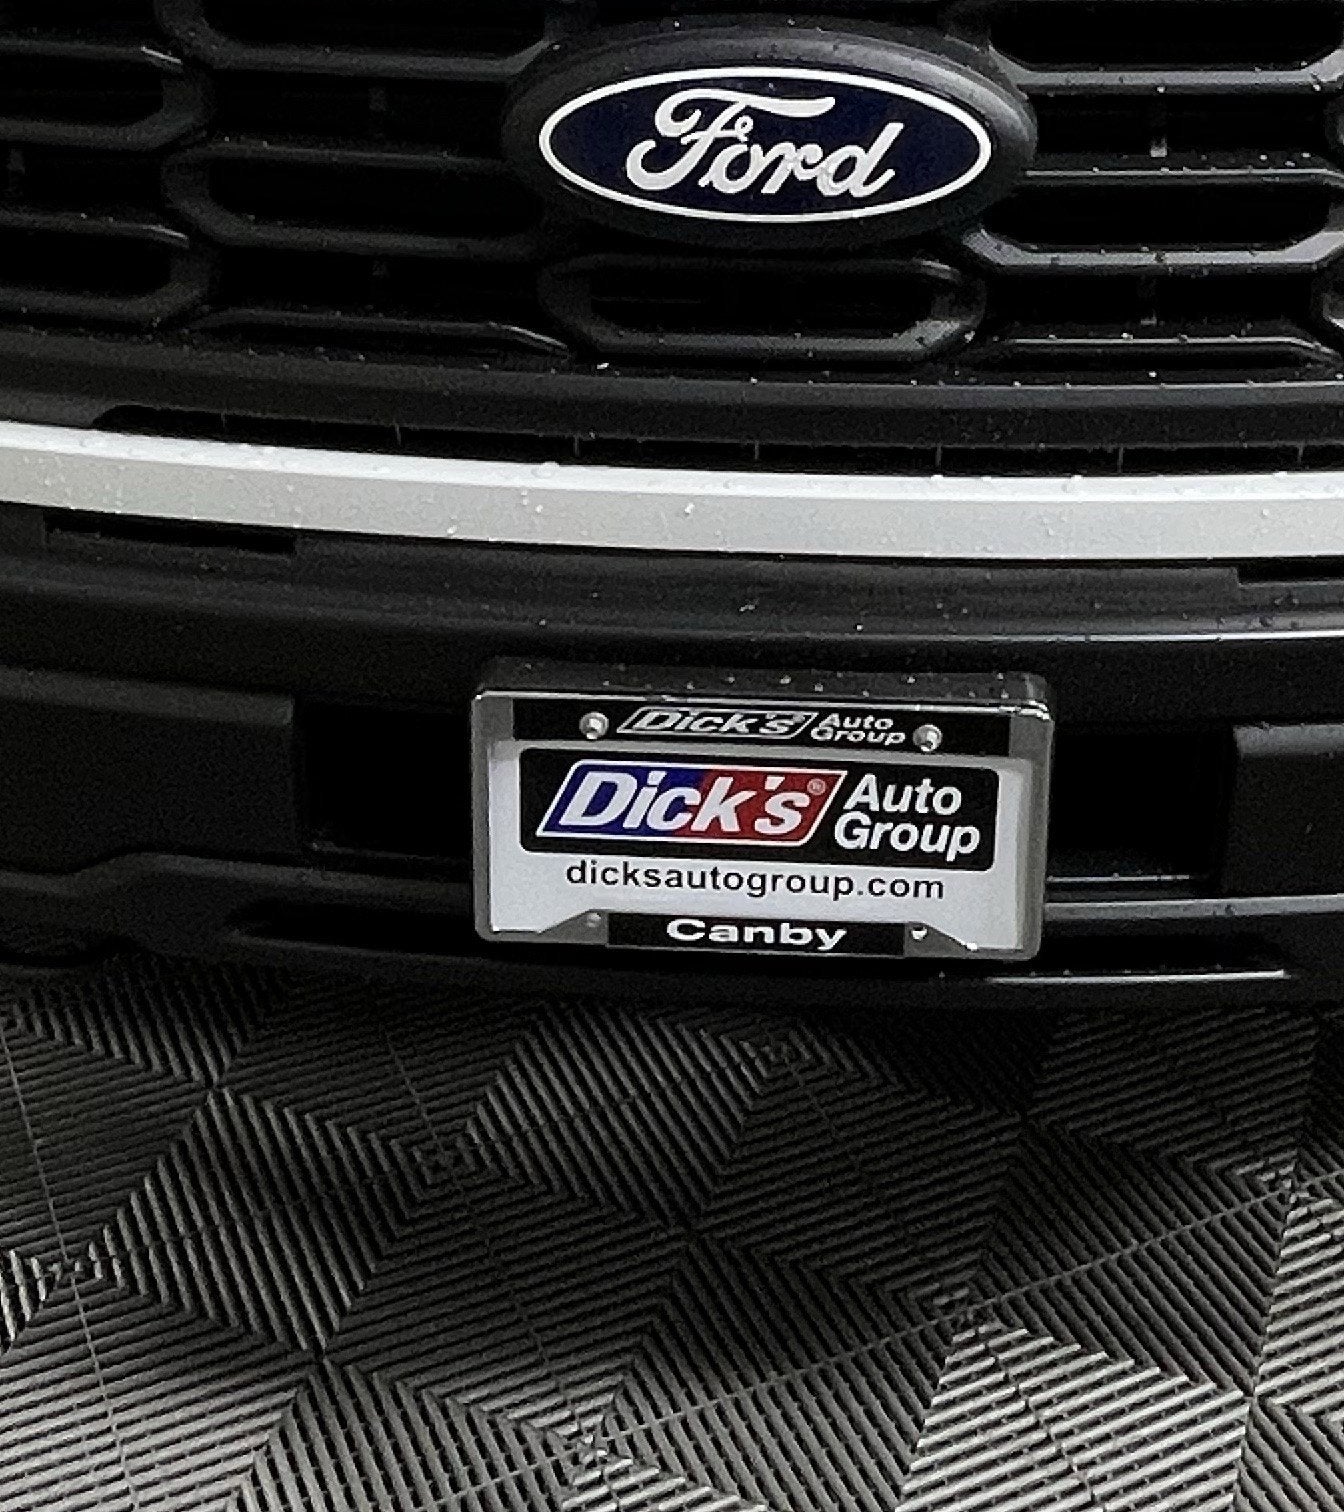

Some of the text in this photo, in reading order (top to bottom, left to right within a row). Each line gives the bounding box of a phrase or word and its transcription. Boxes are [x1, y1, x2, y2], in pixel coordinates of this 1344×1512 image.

[626, 88, 904, 197] Ford
[810, 726, 906, 746] Group
[817, 713, 894, 730] Auto
[558, 769, 811, 835] Dick's
[843, 773, 963, 816] Auto
[834, 810, 981, 862] Group
[565, 859, 945, 900] dicksautogroup.com
[666, 918, 848, 951] Canby
